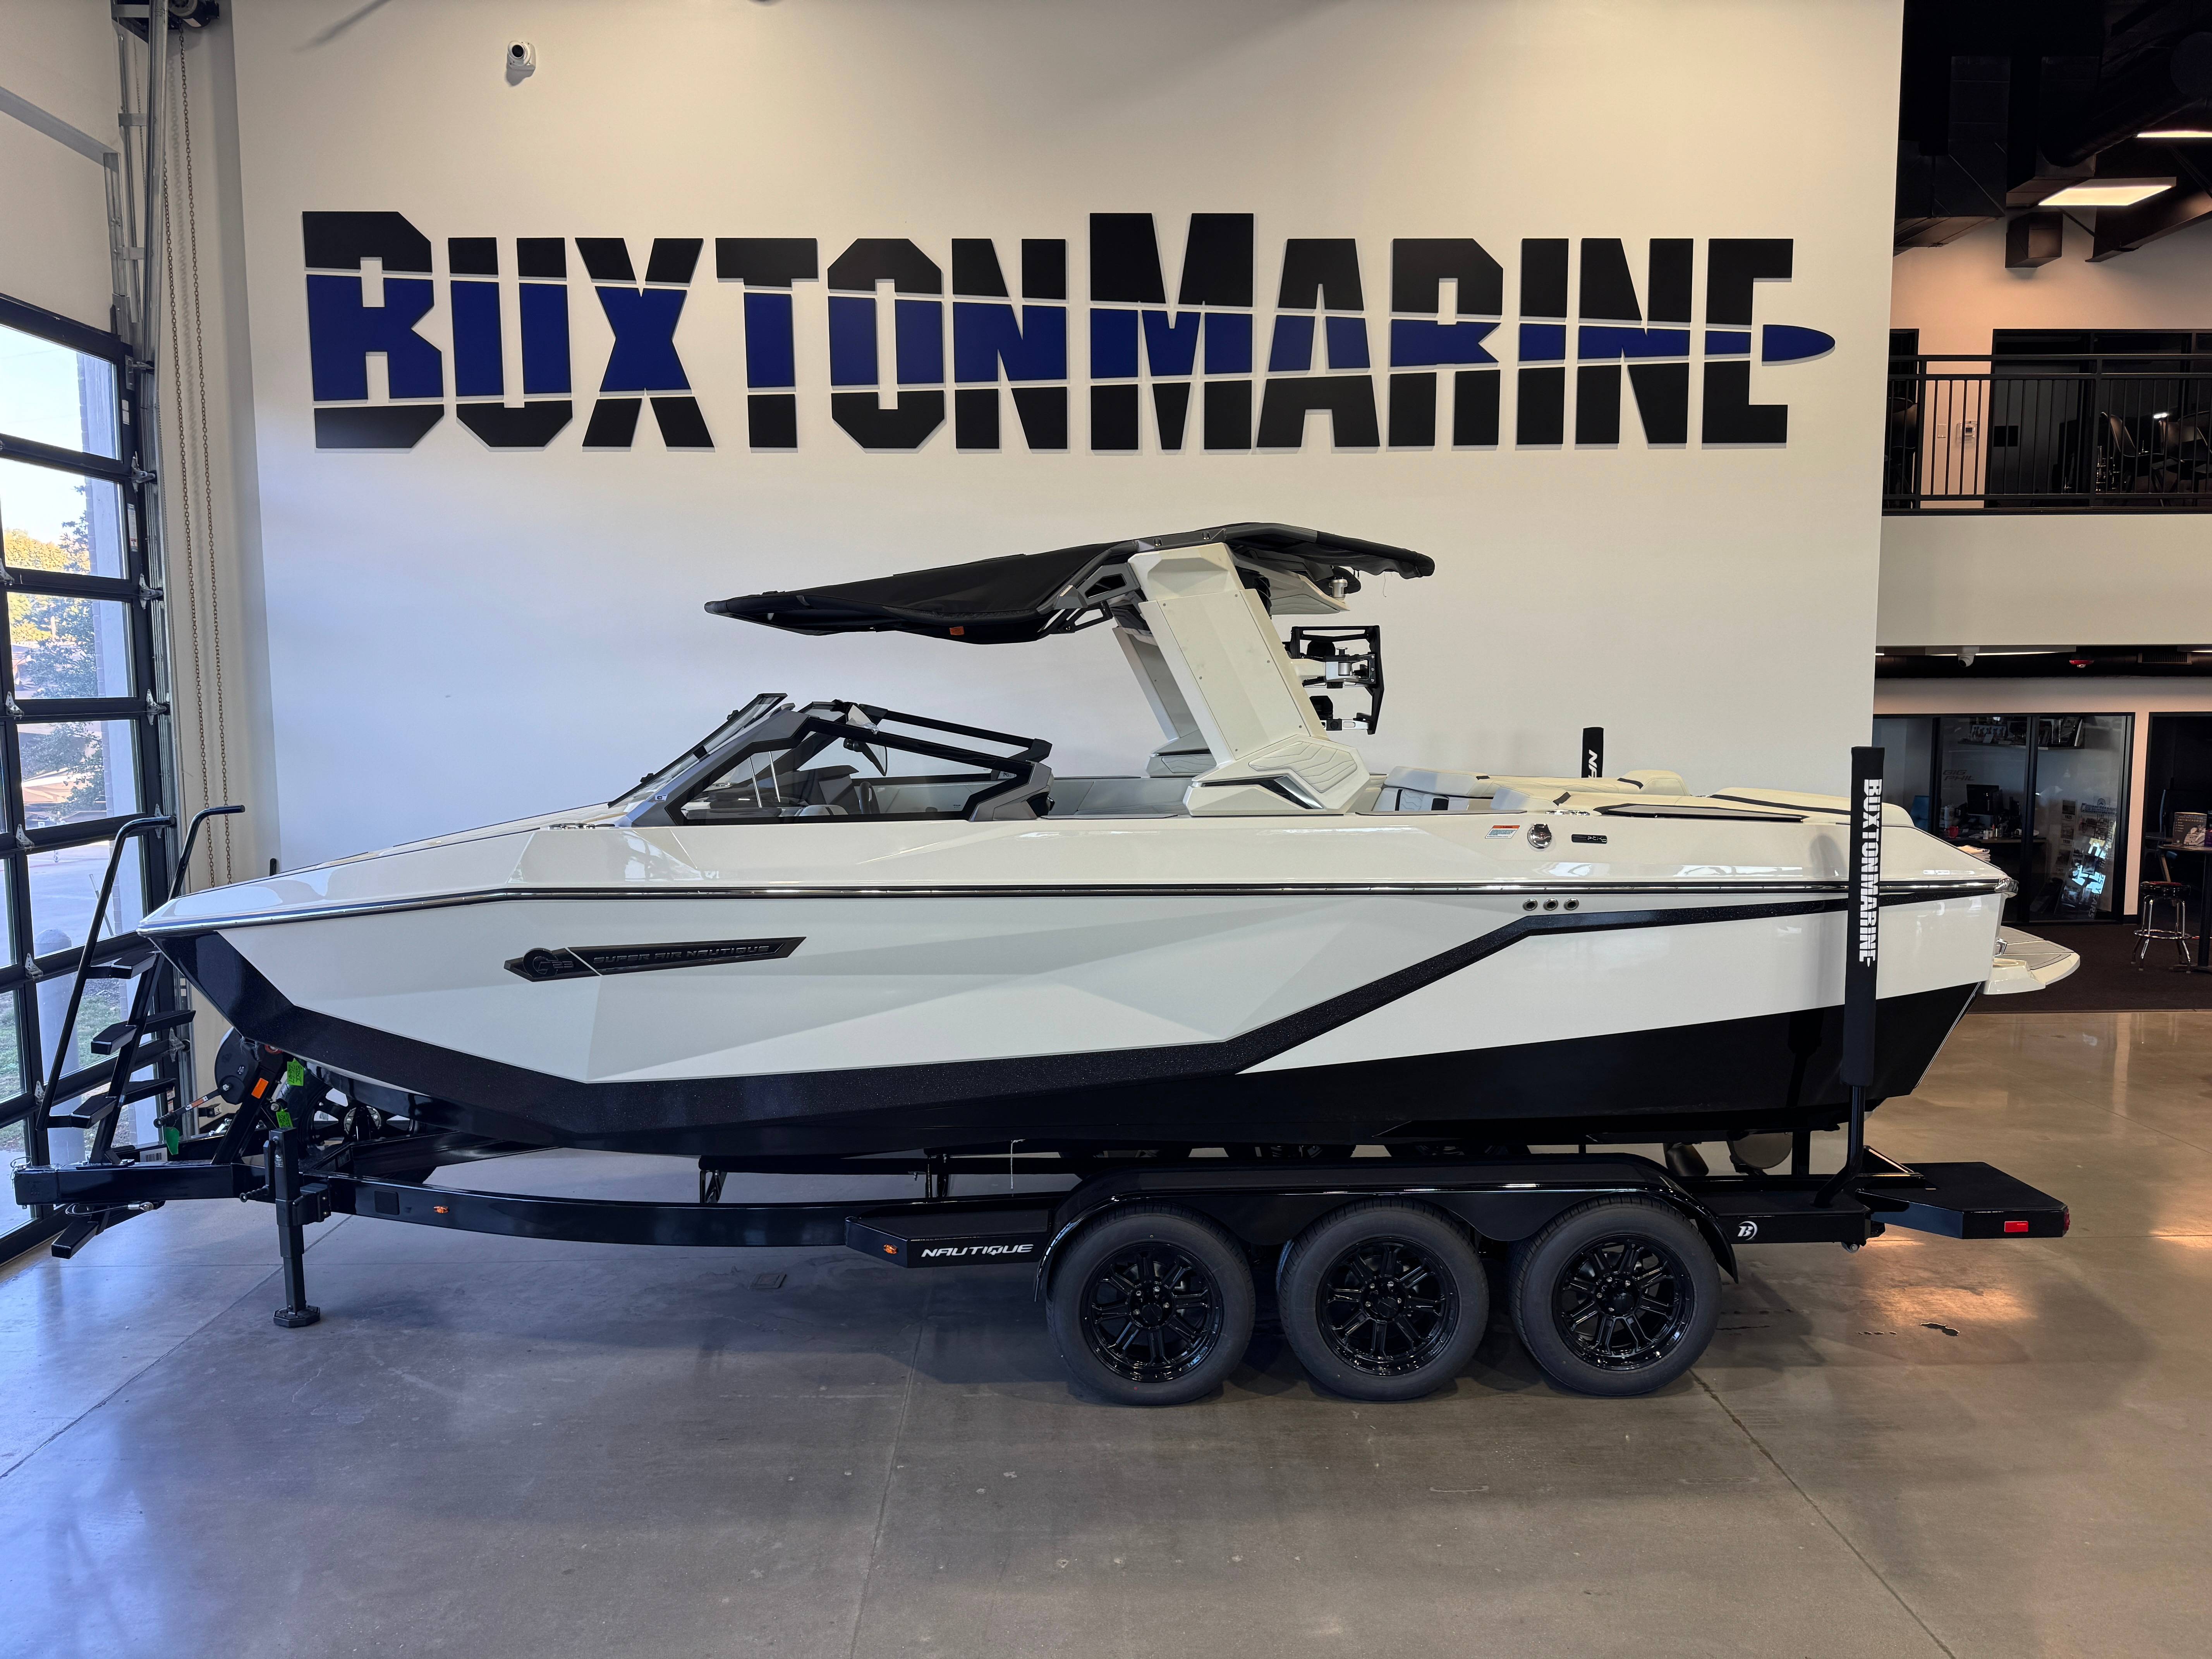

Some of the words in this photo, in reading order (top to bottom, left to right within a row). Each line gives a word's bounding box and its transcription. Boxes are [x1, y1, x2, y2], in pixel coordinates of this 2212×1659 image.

[1859, 779, 1882, 962] BUXTONMARINE
[2088, 888, 2101, 918] YEARS
[593, 954, 650, 963] SUPER
[687, 946, 769, 957] NAUTIQUE
[921, 1244, 1034, 1257] NAUTIQUE
